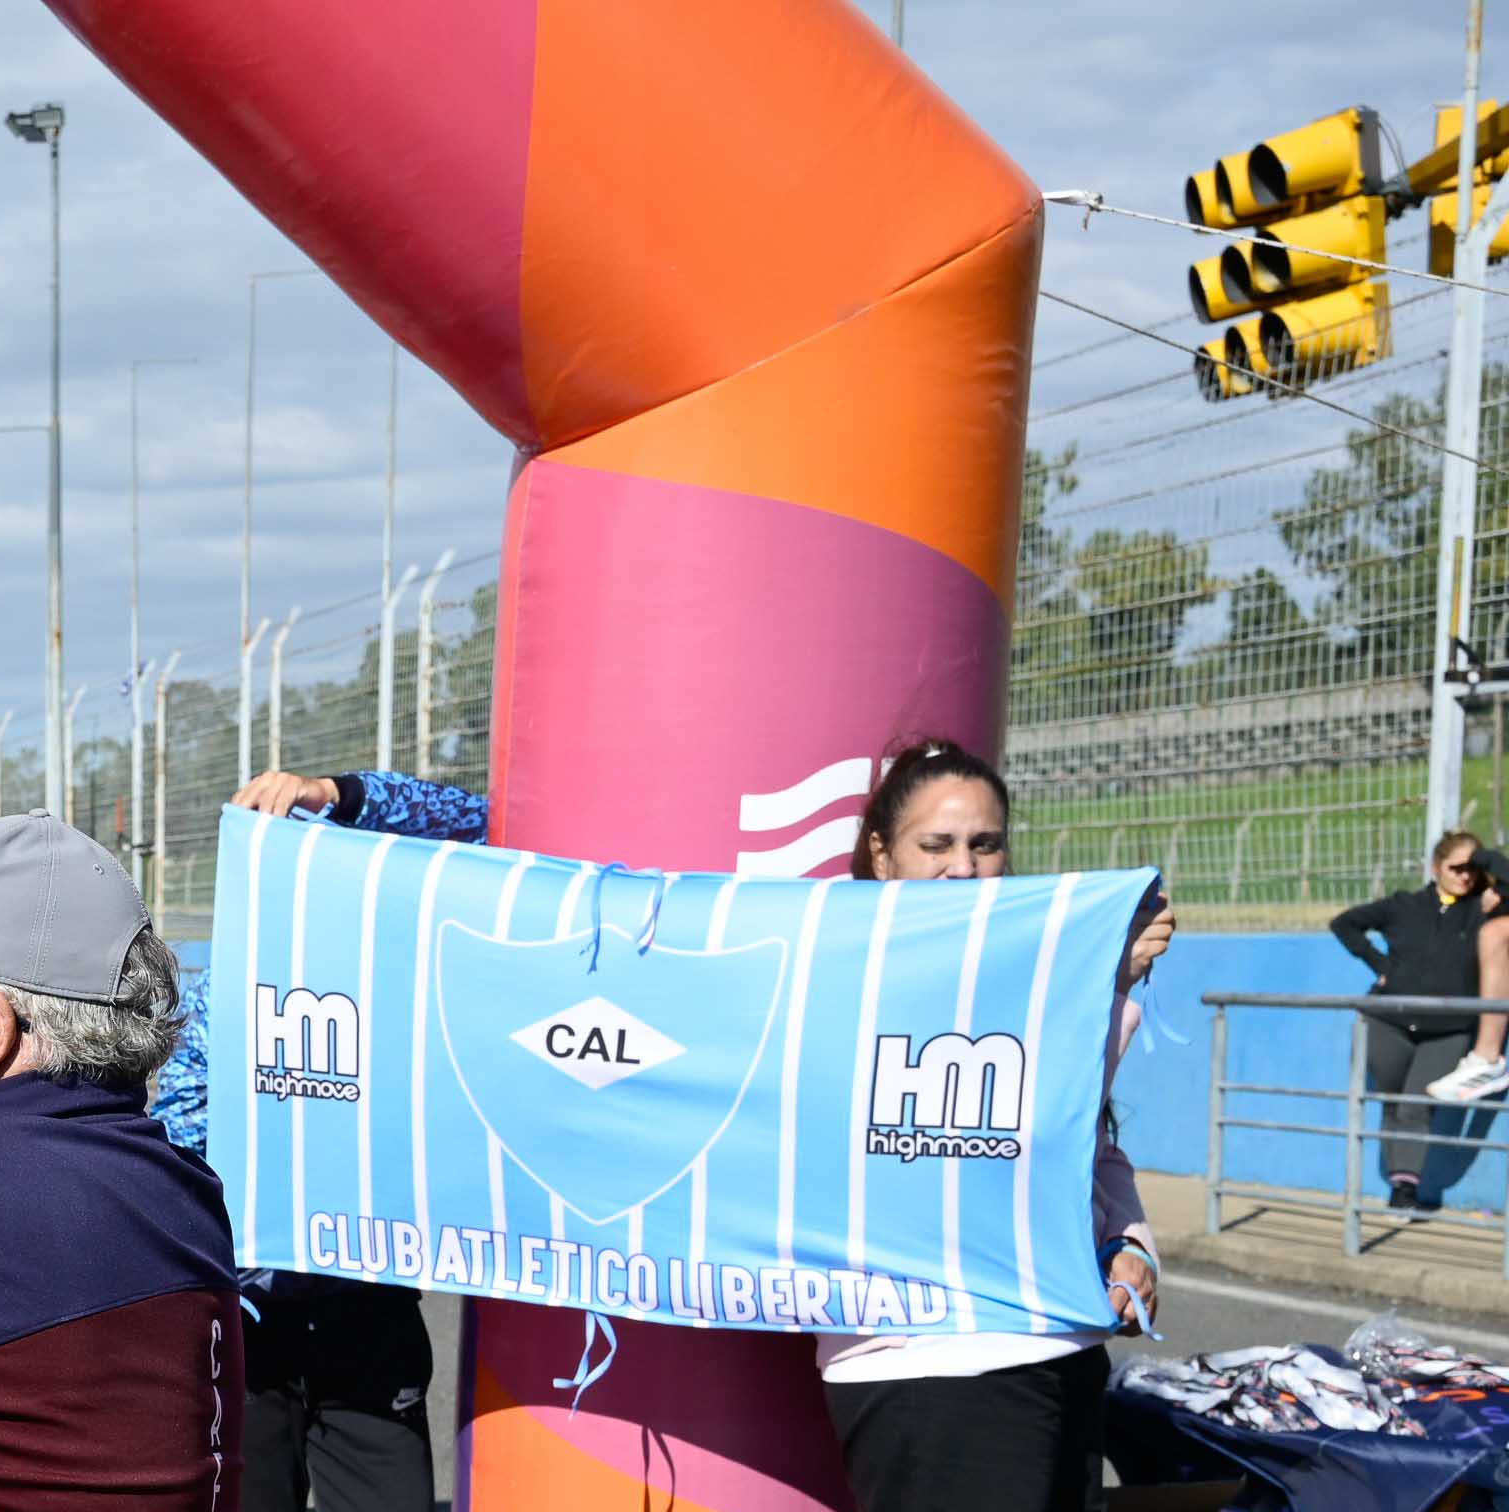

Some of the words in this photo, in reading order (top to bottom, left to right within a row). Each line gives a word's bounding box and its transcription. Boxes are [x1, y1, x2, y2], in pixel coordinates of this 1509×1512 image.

[546, 1024, 640, 1064] CAL
[308, 1211, 423, 1277] CLUB
[433, 1225, 660, 1313] ATLETICO
[667, 1257, 950, 1327] LIBERTAD
